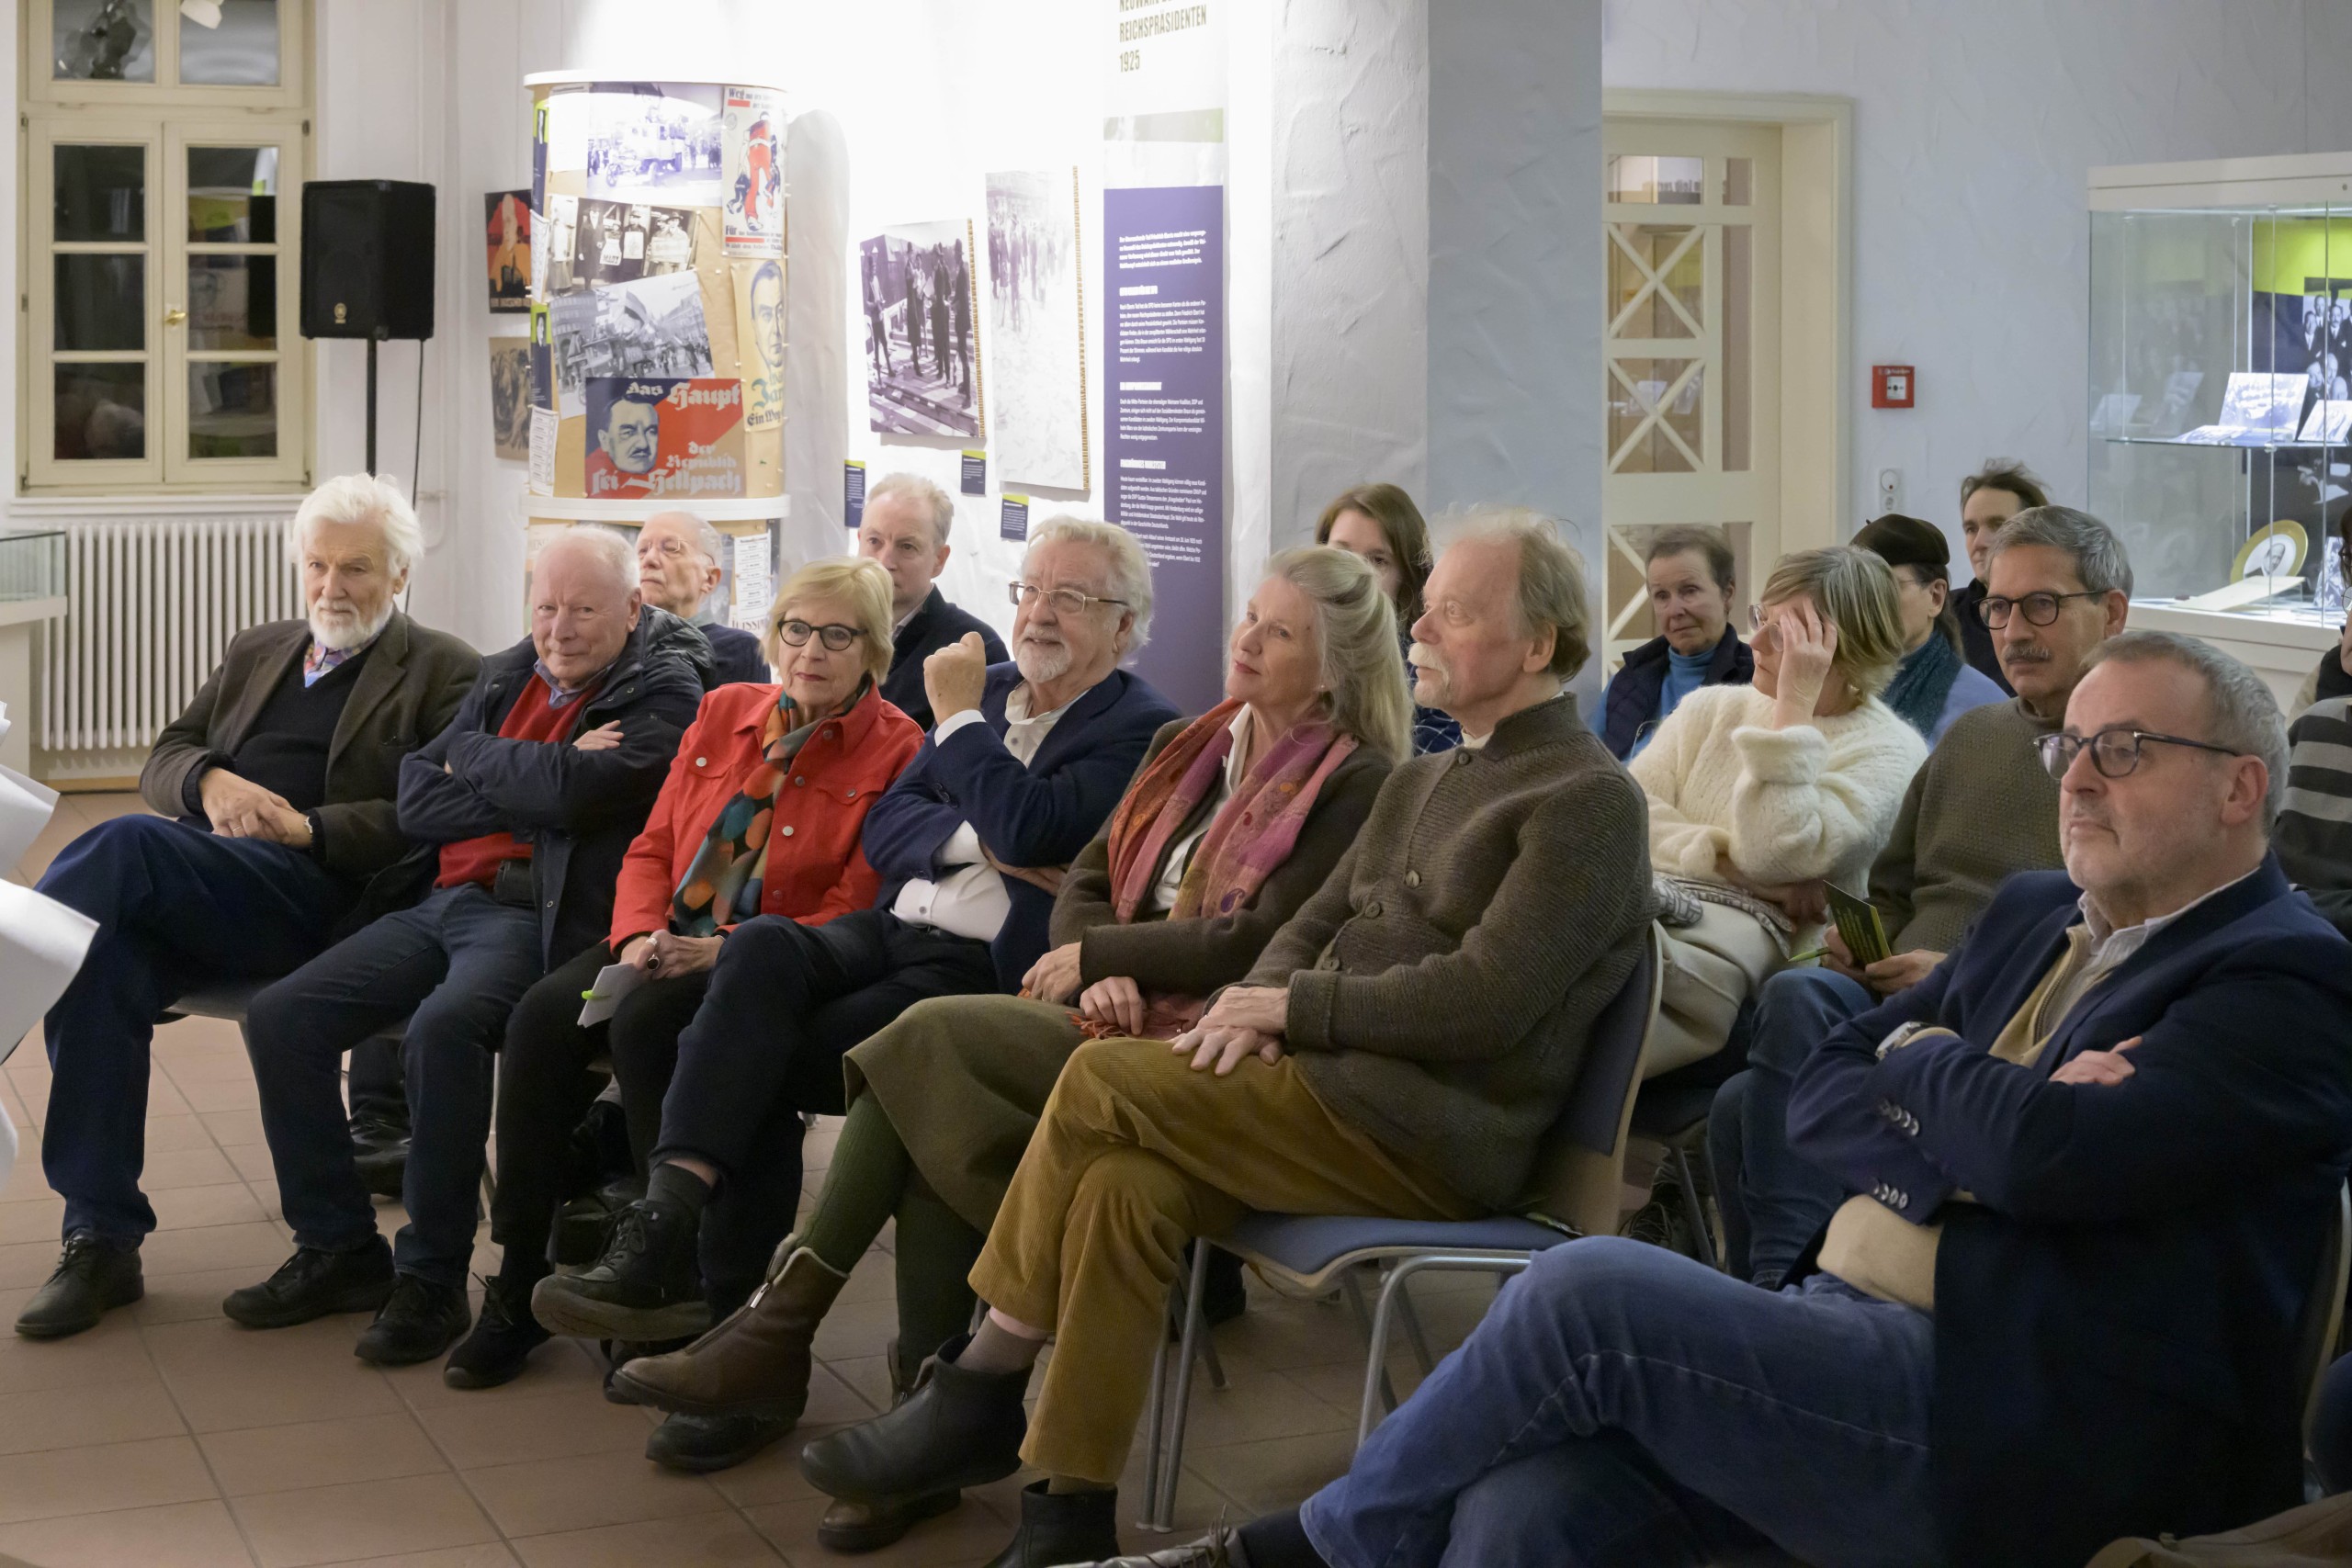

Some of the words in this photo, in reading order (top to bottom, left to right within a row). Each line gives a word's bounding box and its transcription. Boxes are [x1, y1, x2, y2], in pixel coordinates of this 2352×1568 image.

[1119, 5, 1206, 42] REICHSPRÄSIDENTEN
[1119, 50, 1140, 73] 1925
[666, 382, 741, 411] Haupt
[688, 441, 716, 455] der
